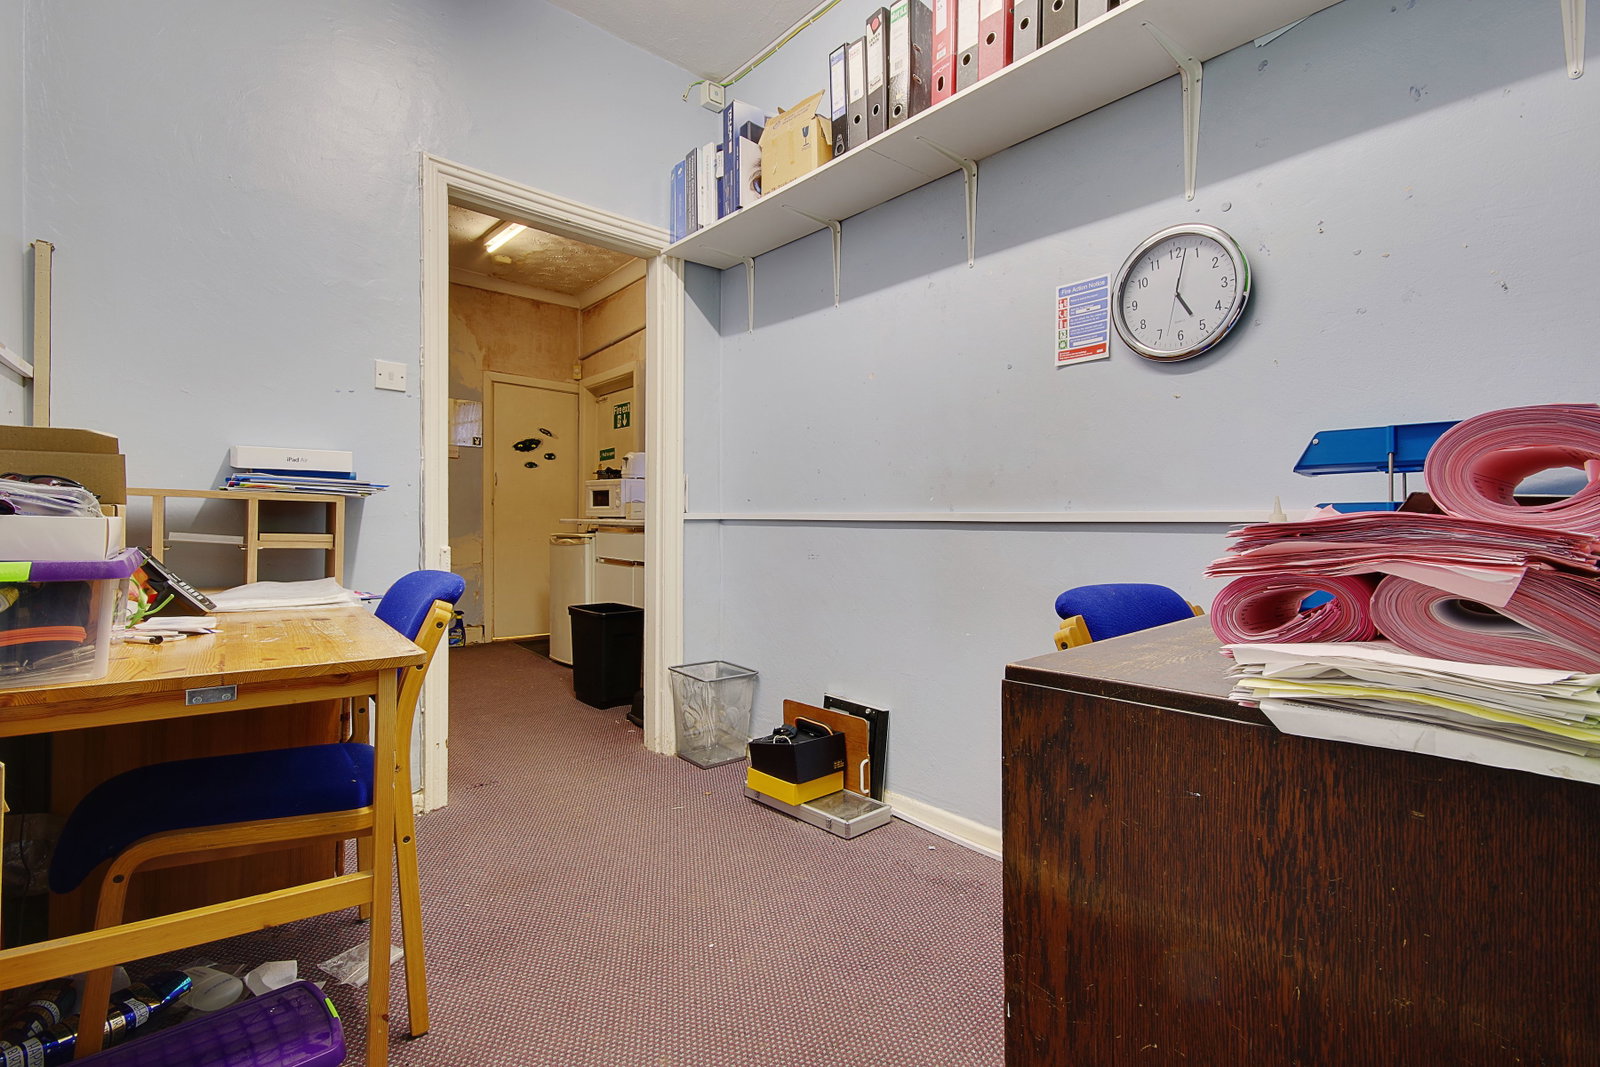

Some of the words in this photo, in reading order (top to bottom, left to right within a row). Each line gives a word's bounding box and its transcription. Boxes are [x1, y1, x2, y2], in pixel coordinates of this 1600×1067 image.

[1169, 247, 1182, 260] 12
[1195, 247, 1199, 258] 1
[1150, 259, 1160, 271] 11
[1211, 256, 1219, 269] 2
[1072, 284, 1088, 293] Action
[1088, 280, 1105, 289] Notice
[1137, 277, 1149, 289] 10
[1221, 276, 1228, 288] 3
[1131, 300, 1138, 311] 9
[1214, 300, 1222, 311] 4
[1140, 319, 1147, 330] 8
[1199, 318, 1206, 330] 5
[1156, 329, 1163, 340] 7
[1177, 330, 1184, 341] 6
